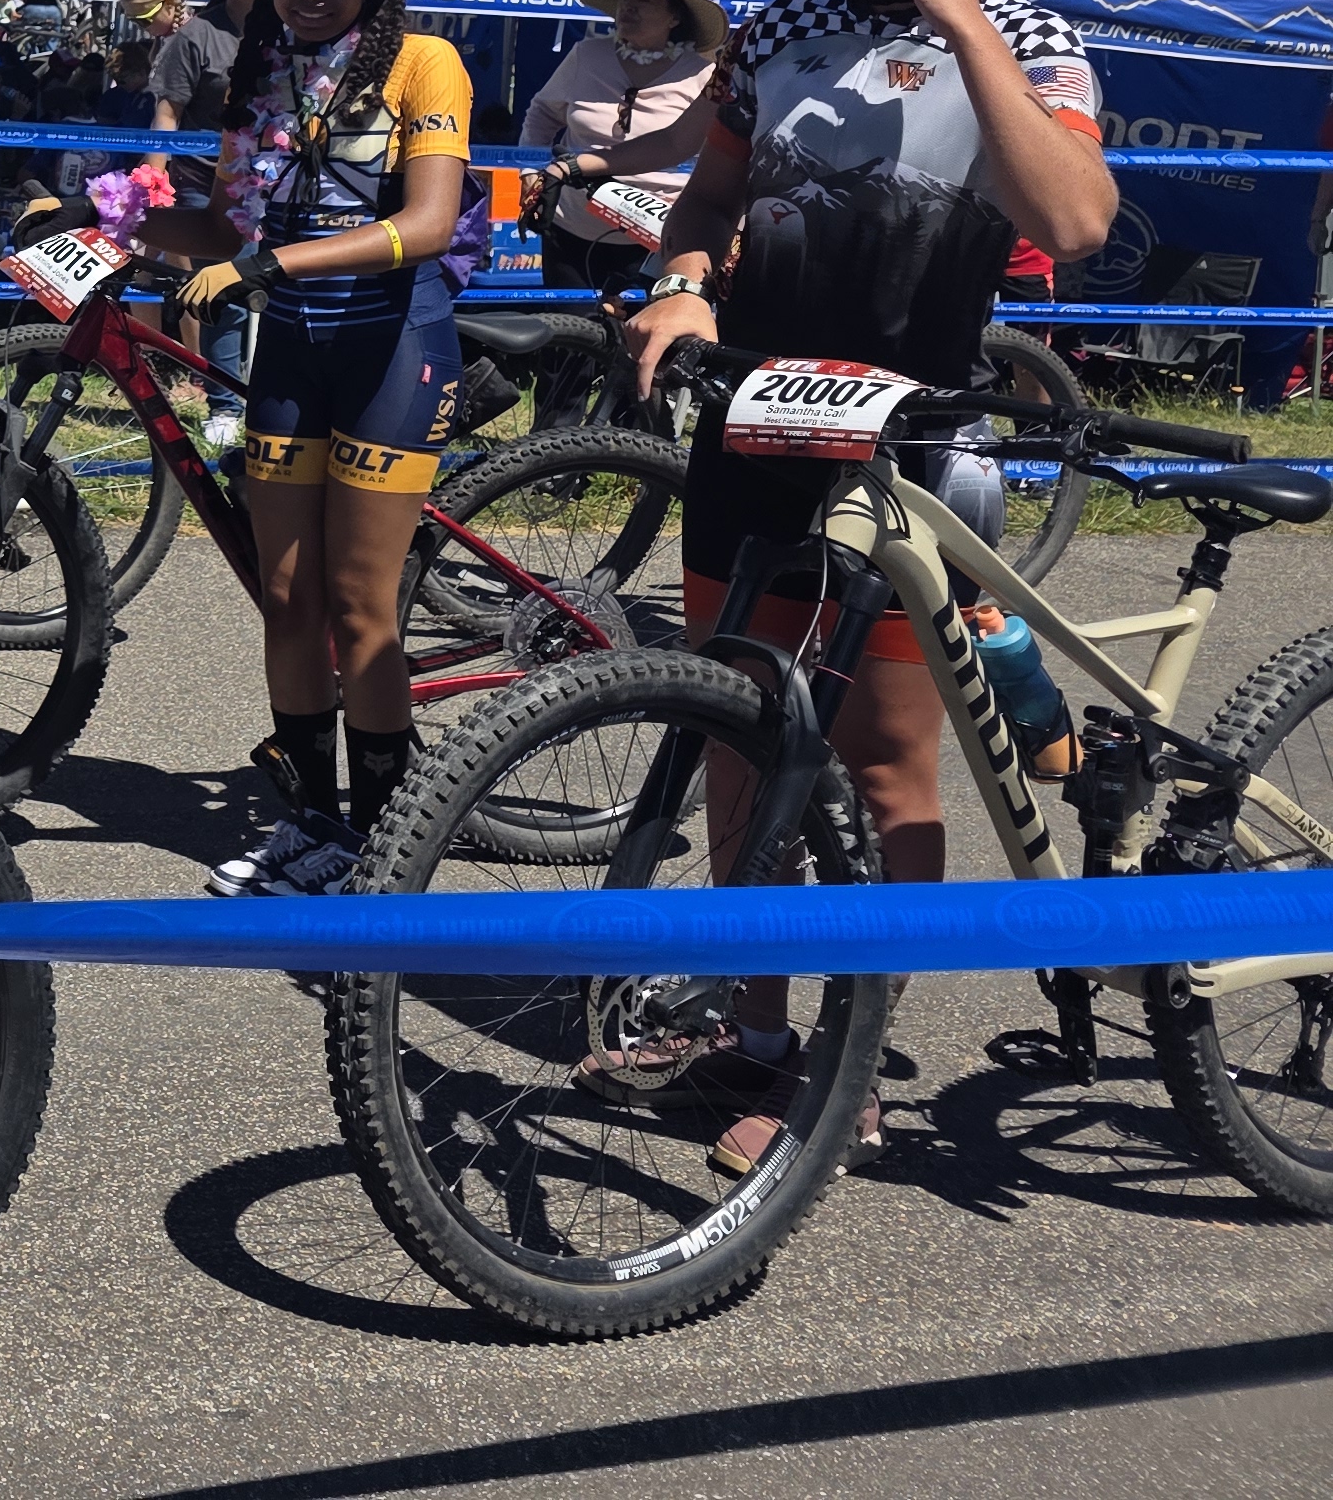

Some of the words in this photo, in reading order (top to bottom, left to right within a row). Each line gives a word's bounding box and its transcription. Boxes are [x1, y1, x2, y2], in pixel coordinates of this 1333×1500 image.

[1195, 35, 1256, 52] BIKE
[409, 113, 459, 135] WSA
[316, 213, 365, 227] VOLT
[35, 233, 101, 282] 20015
[90, 236, 123, 266] 2026
[750, 374, 894, 408] 20007
[426, 380, 458, 442] WSA
[764, 416, 782, 425] West
[819, 419, 840, 428] Team
[765, 404, 821, 418] Samantha
[824, 407, 847, 419] Call
[933, 597, 1050, 864] GHOST
[677, 1197, 752, 1262] M502
[615, 1267, 632, 1281] DT
[632, 1260, 661, 1278] SWISS
